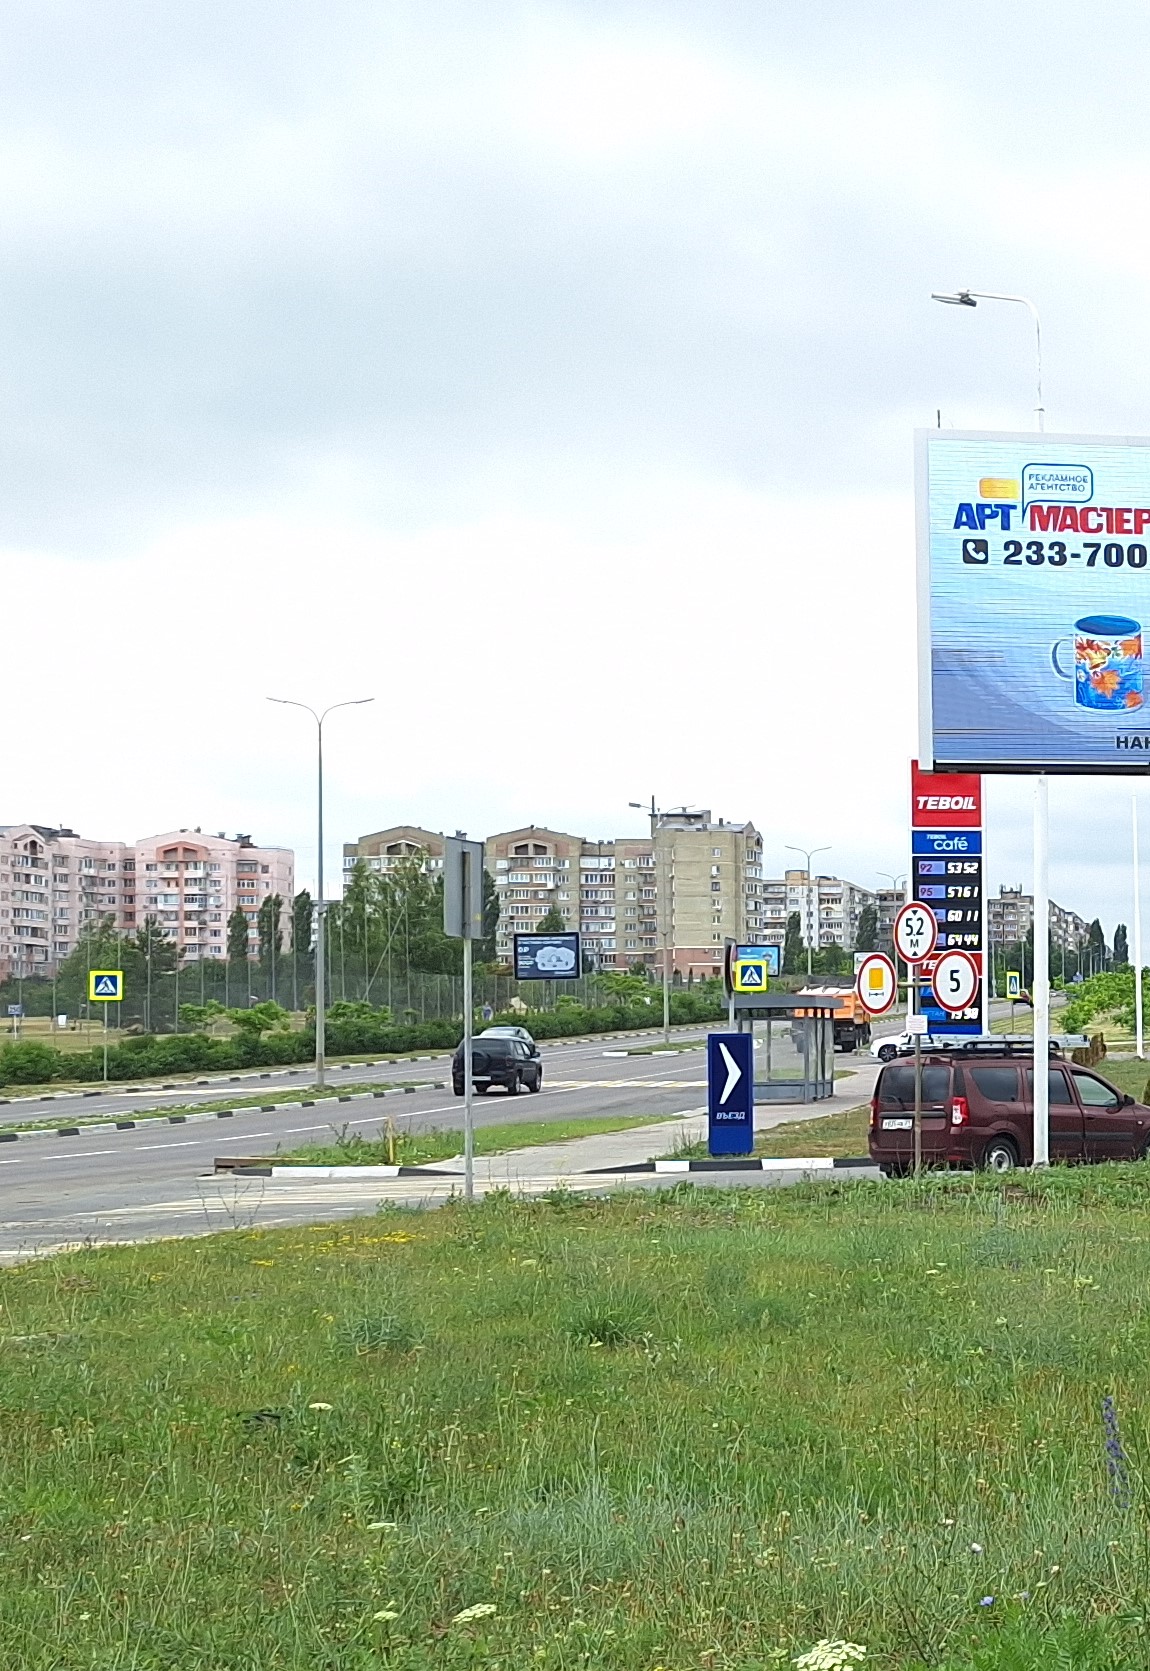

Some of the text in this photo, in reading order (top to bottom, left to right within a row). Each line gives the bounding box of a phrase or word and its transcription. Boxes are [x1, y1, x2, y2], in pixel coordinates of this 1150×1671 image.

[1029, 473, 1089, 483] РЕКЛАМНОЕ
[1028, 482, 1085, 492] АГЕНТСТВО
[953, 502, 1018, 531] АРТ
[1003, 540, 1148, 568] 233-700
[916, 796, 977, 810] TEBOIL
[934, 836, 968, 851] café
[920, 863, 933, 873] 92
[920, 887, 933, 896] 95
[949, 969, 961, 993] 5
